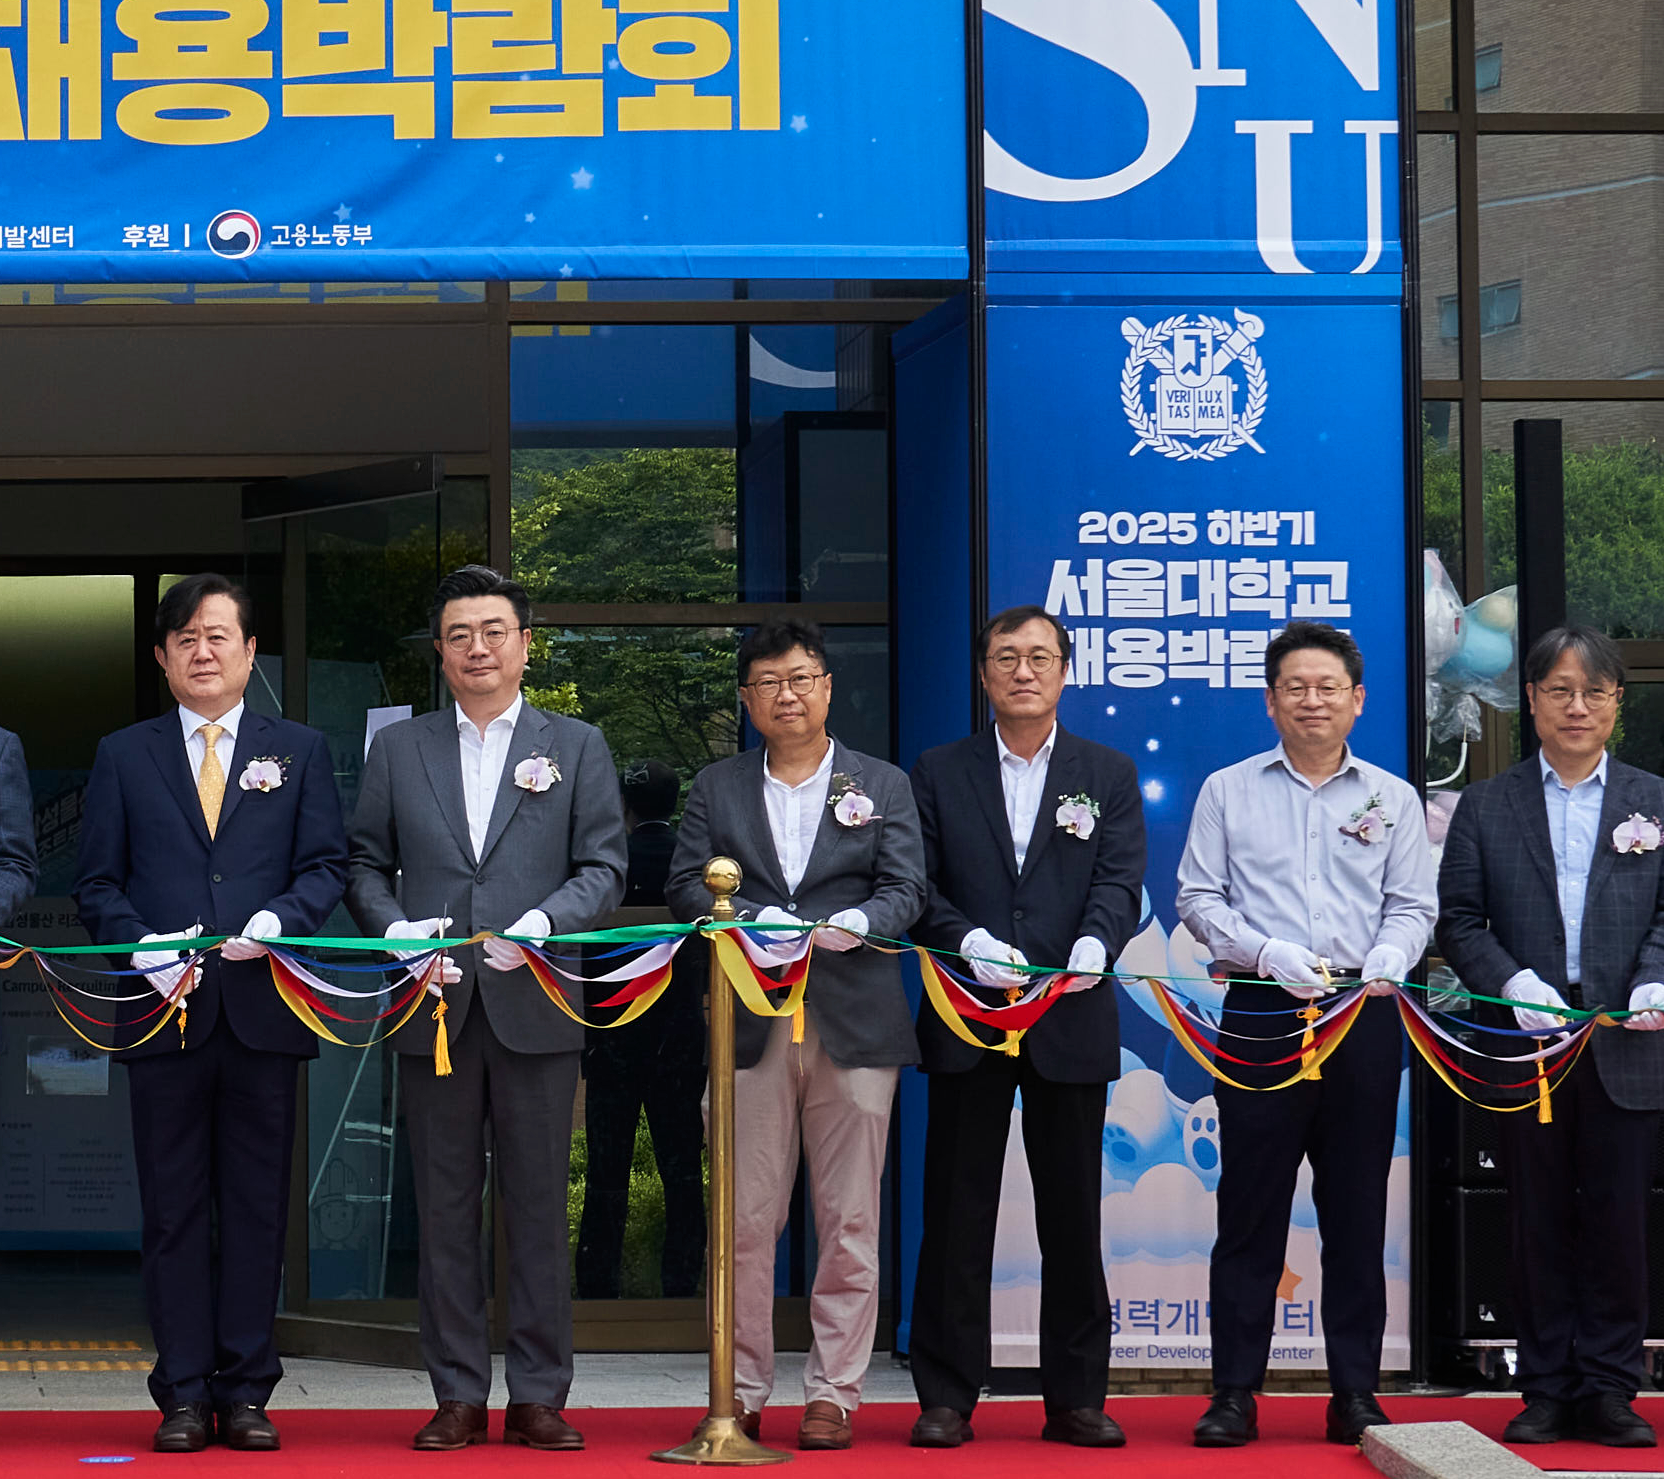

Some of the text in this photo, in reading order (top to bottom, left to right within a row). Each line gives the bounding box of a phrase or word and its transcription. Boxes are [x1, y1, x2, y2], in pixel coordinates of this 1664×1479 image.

[122, 224, 170, 252] 후원
[270, 223, 373, 248] 고용노동부
[1165, 389, 1222, 403] VERI LUX
[1167, 405, 1225, 419] TAS MEA
[1078, 510, 1315, 547] 2025 하반기
[1045, 557, 1351, 619] 서울대학교
